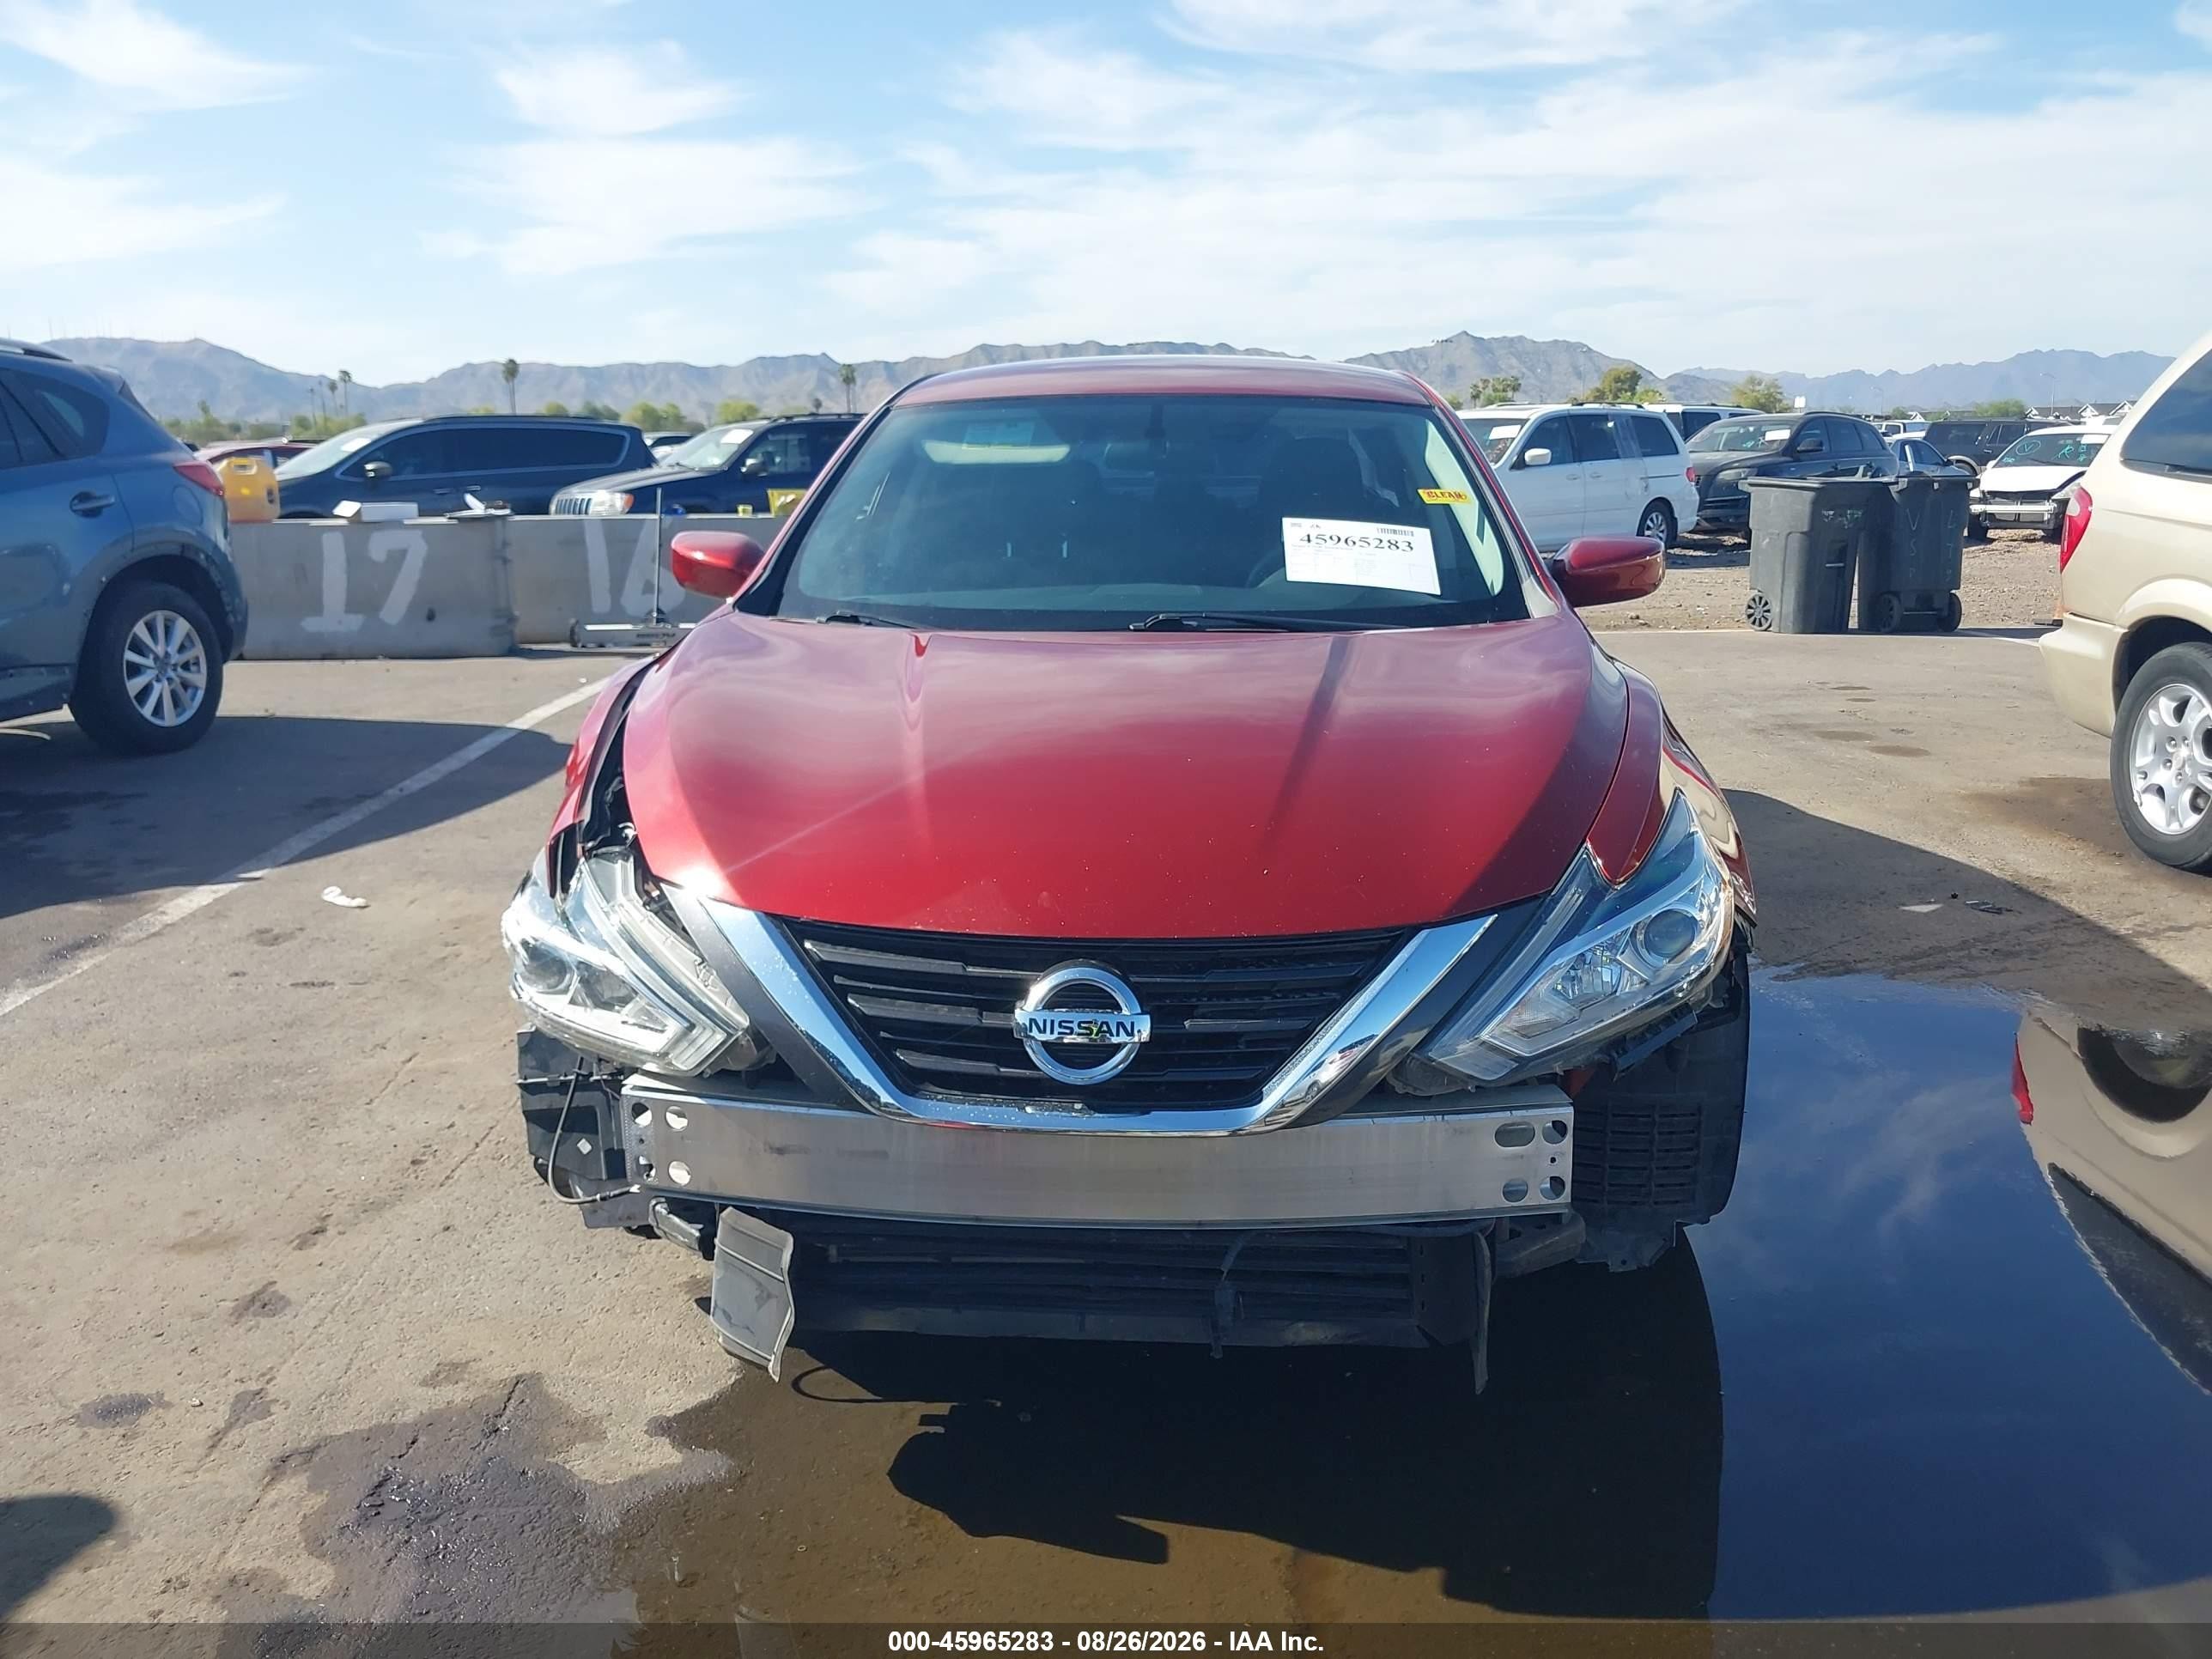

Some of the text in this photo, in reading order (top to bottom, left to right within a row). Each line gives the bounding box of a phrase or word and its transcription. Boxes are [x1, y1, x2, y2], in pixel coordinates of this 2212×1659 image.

[583, 520, 686, 617] 16
[1299, 533, 1414, 553] 45965283
[300, 529, 429, 632] 17
[1028, 1018, 1135, 1037] NISSAN
